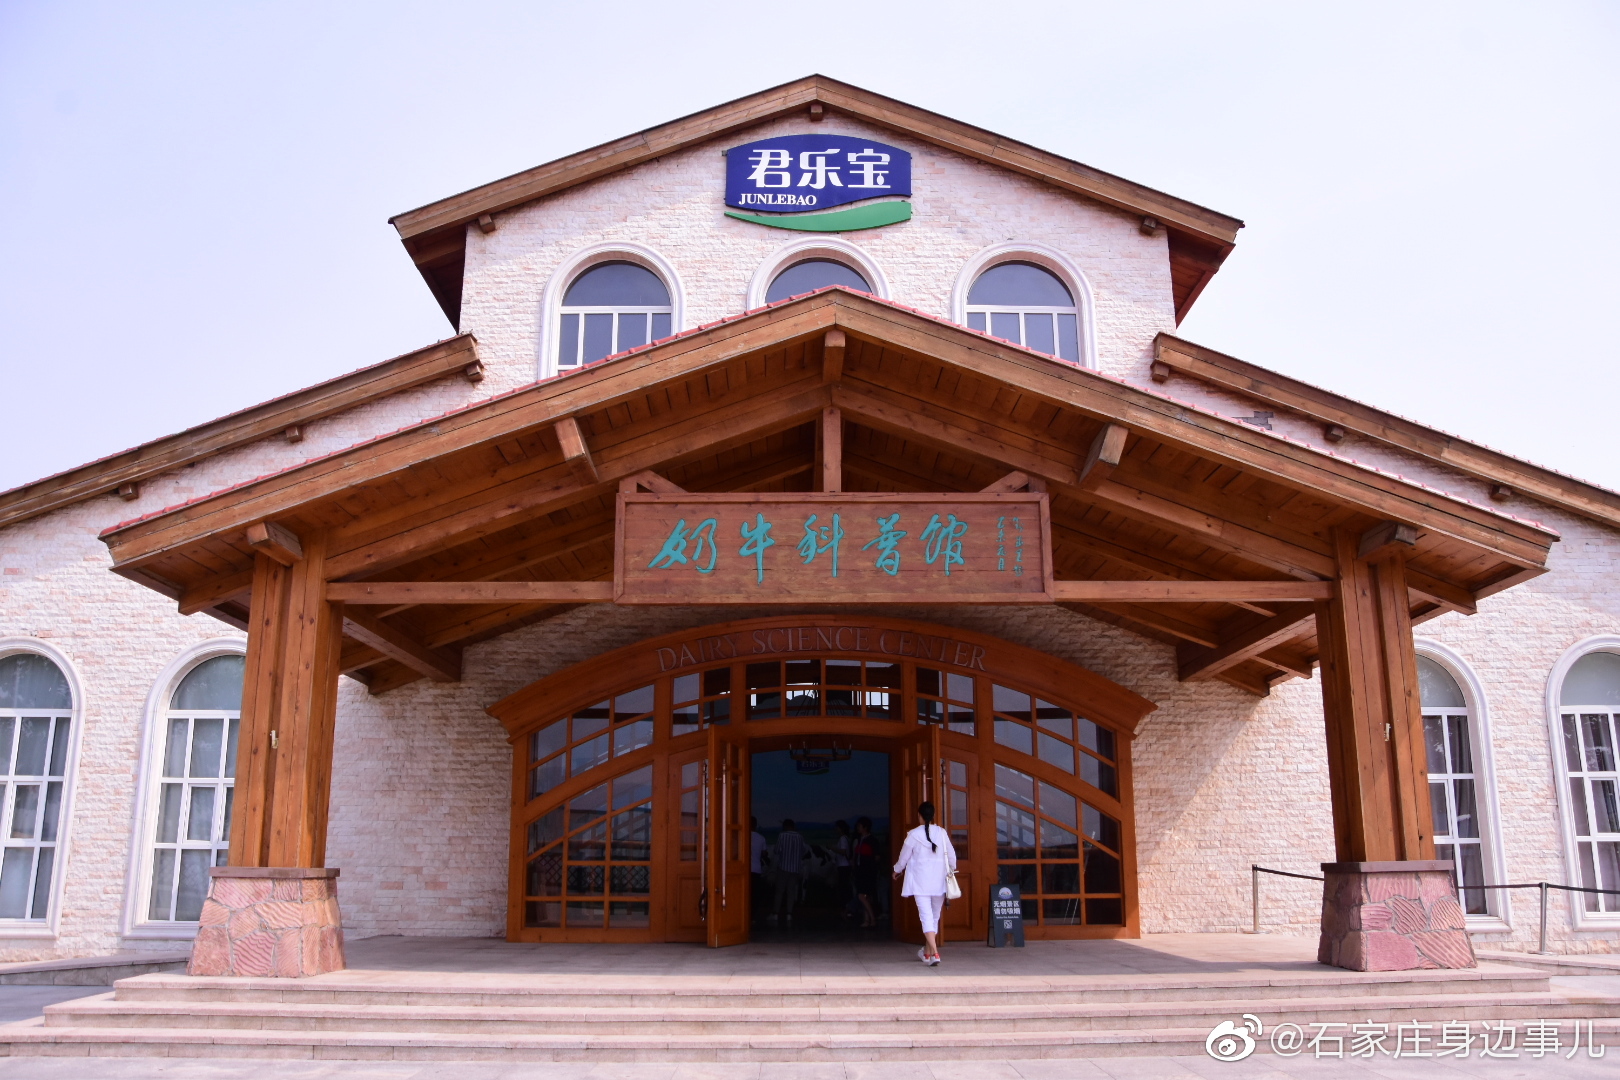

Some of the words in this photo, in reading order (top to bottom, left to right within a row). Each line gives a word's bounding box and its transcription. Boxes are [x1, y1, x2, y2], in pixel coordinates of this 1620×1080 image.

[747, 148, 892, 189] 君乐宝
[738, 193, 817, 206] JUNLEBAO
[647, 512, 969, 587] 奶牛科普馆
[656, 633, 743, 672] DAIRY
[751, 626, 871, 655] SCIENCE
[879, 631, 987, 672] CENTER
